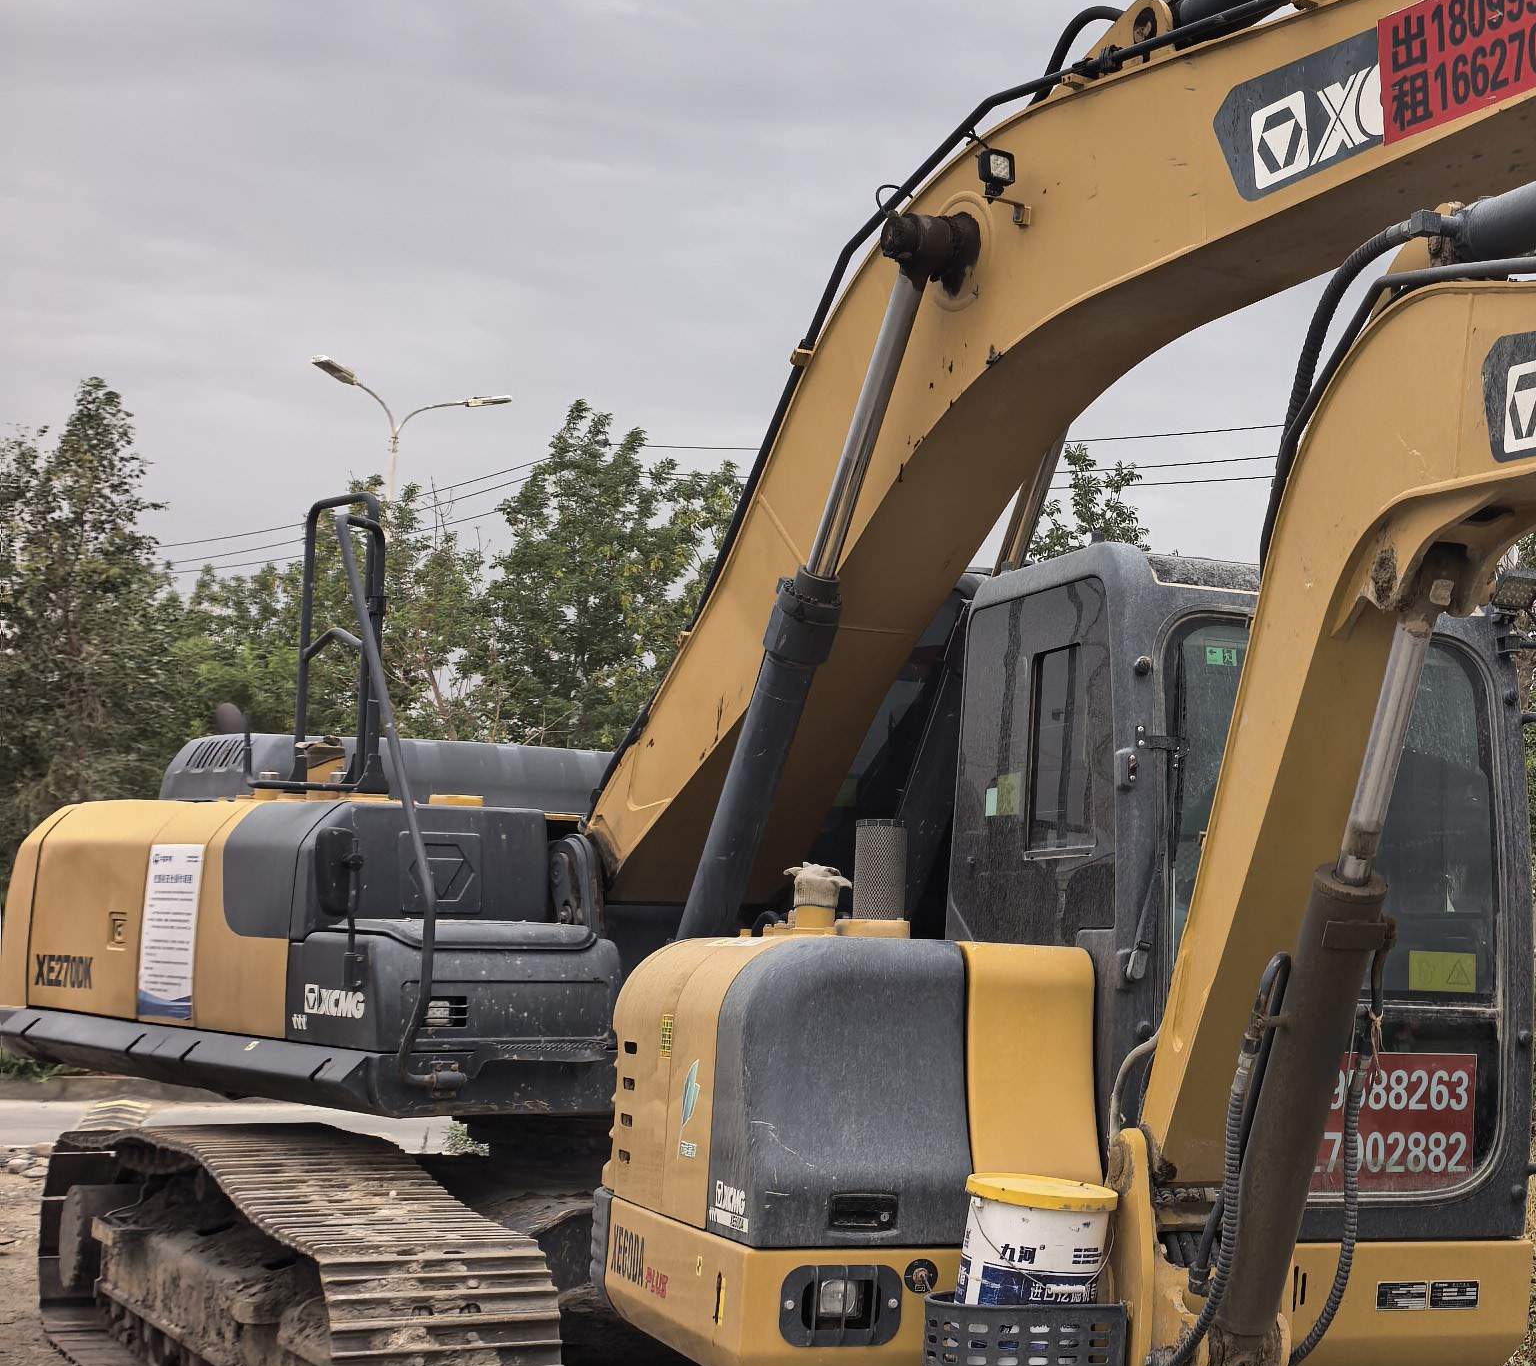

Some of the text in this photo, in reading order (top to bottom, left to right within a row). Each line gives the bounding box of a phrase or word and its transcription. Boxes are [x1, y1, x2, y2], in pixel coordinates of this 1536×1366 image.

[317, 988, 365, 1019] XCMG
[1314, 1131, 1467, 1173] 702882
[723, 1184, 746, 1216] XCMG
